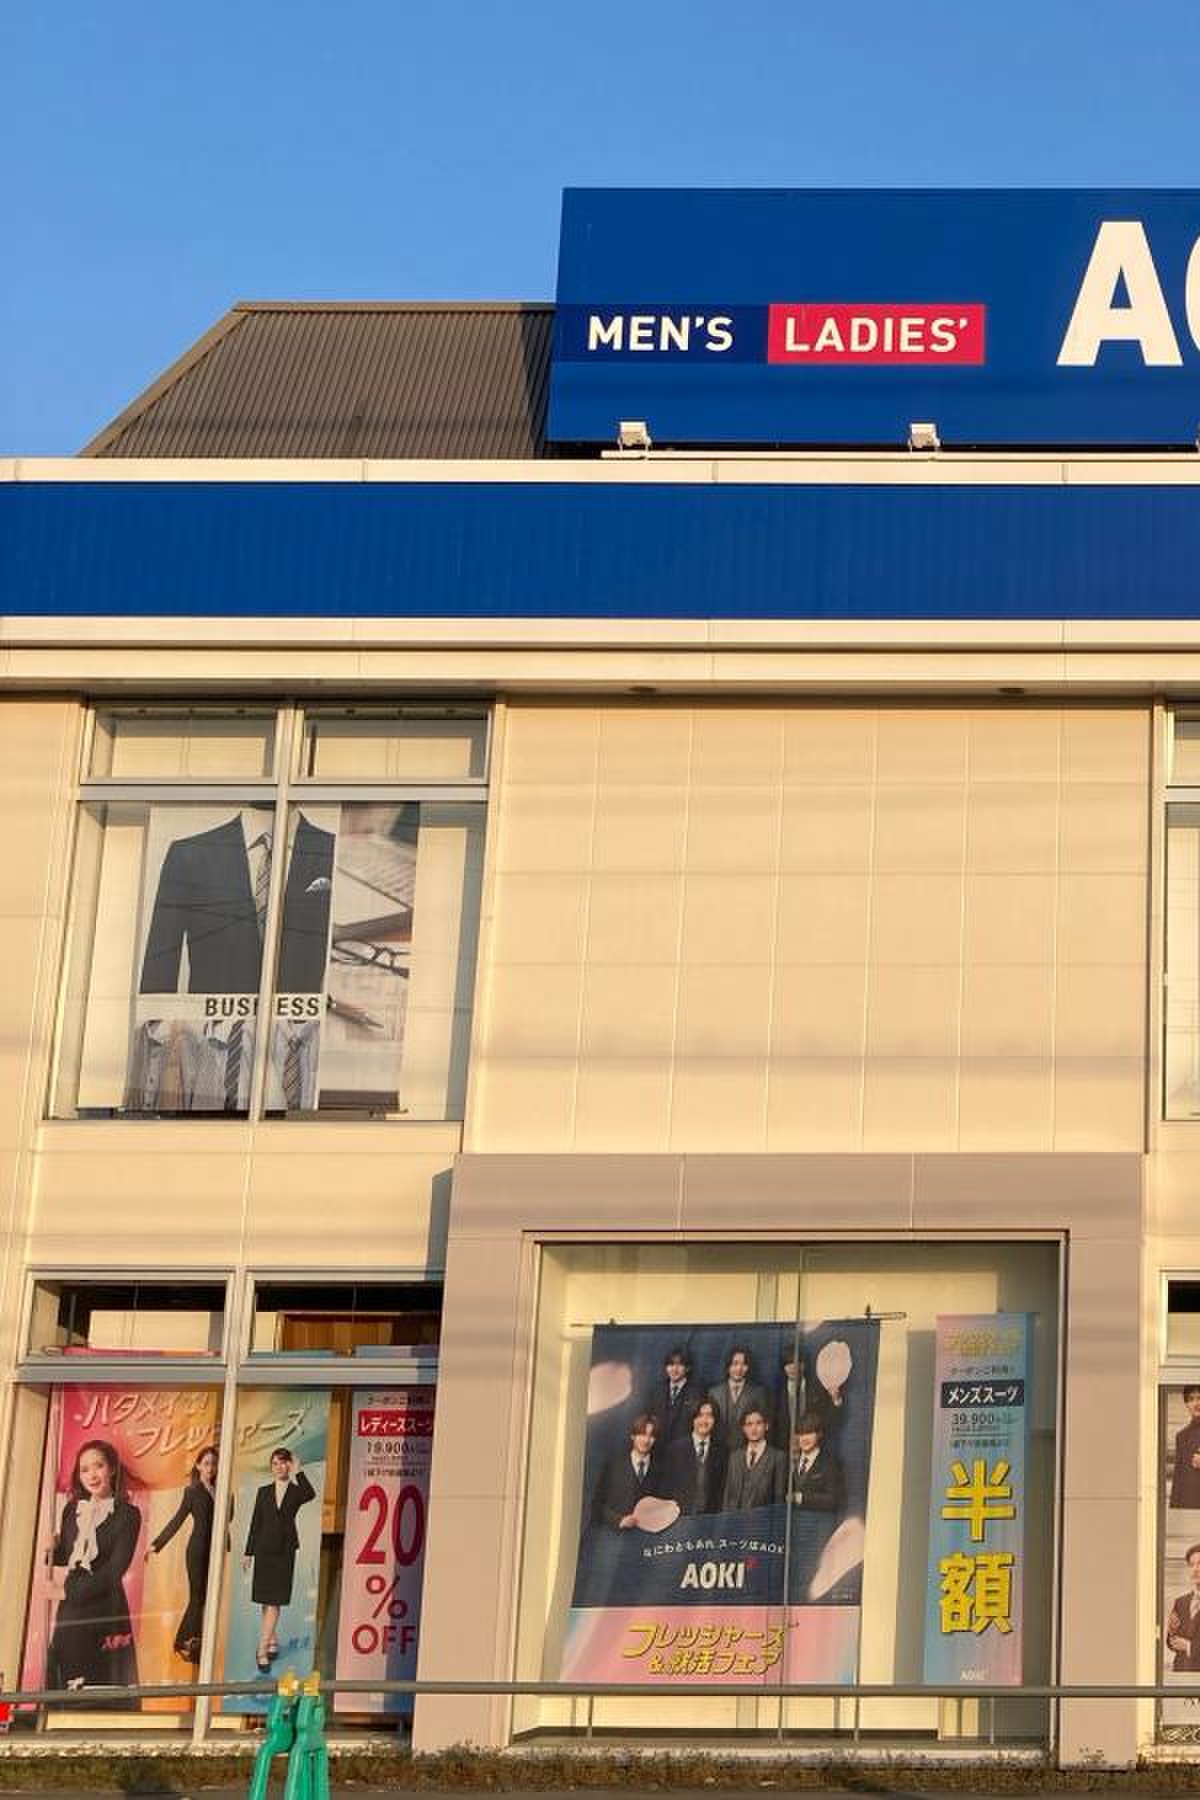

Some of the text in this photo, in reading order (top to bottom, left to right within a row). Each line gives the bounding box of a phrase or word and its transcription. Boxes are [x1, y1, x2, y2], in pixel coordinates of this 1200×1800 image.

[587, 315, 734, 352] MEN'S
[784, 317, 970, 354] LADIES'
[205, 996, 320, 1016] BUSIESS
[947, 1385, 1019, 1405] メンズスーツ
[355, 1484, 425, 1567] 20
[940, 1459, 1016, 1633] 半額
[351, 1623, 416, 1656] OFF
